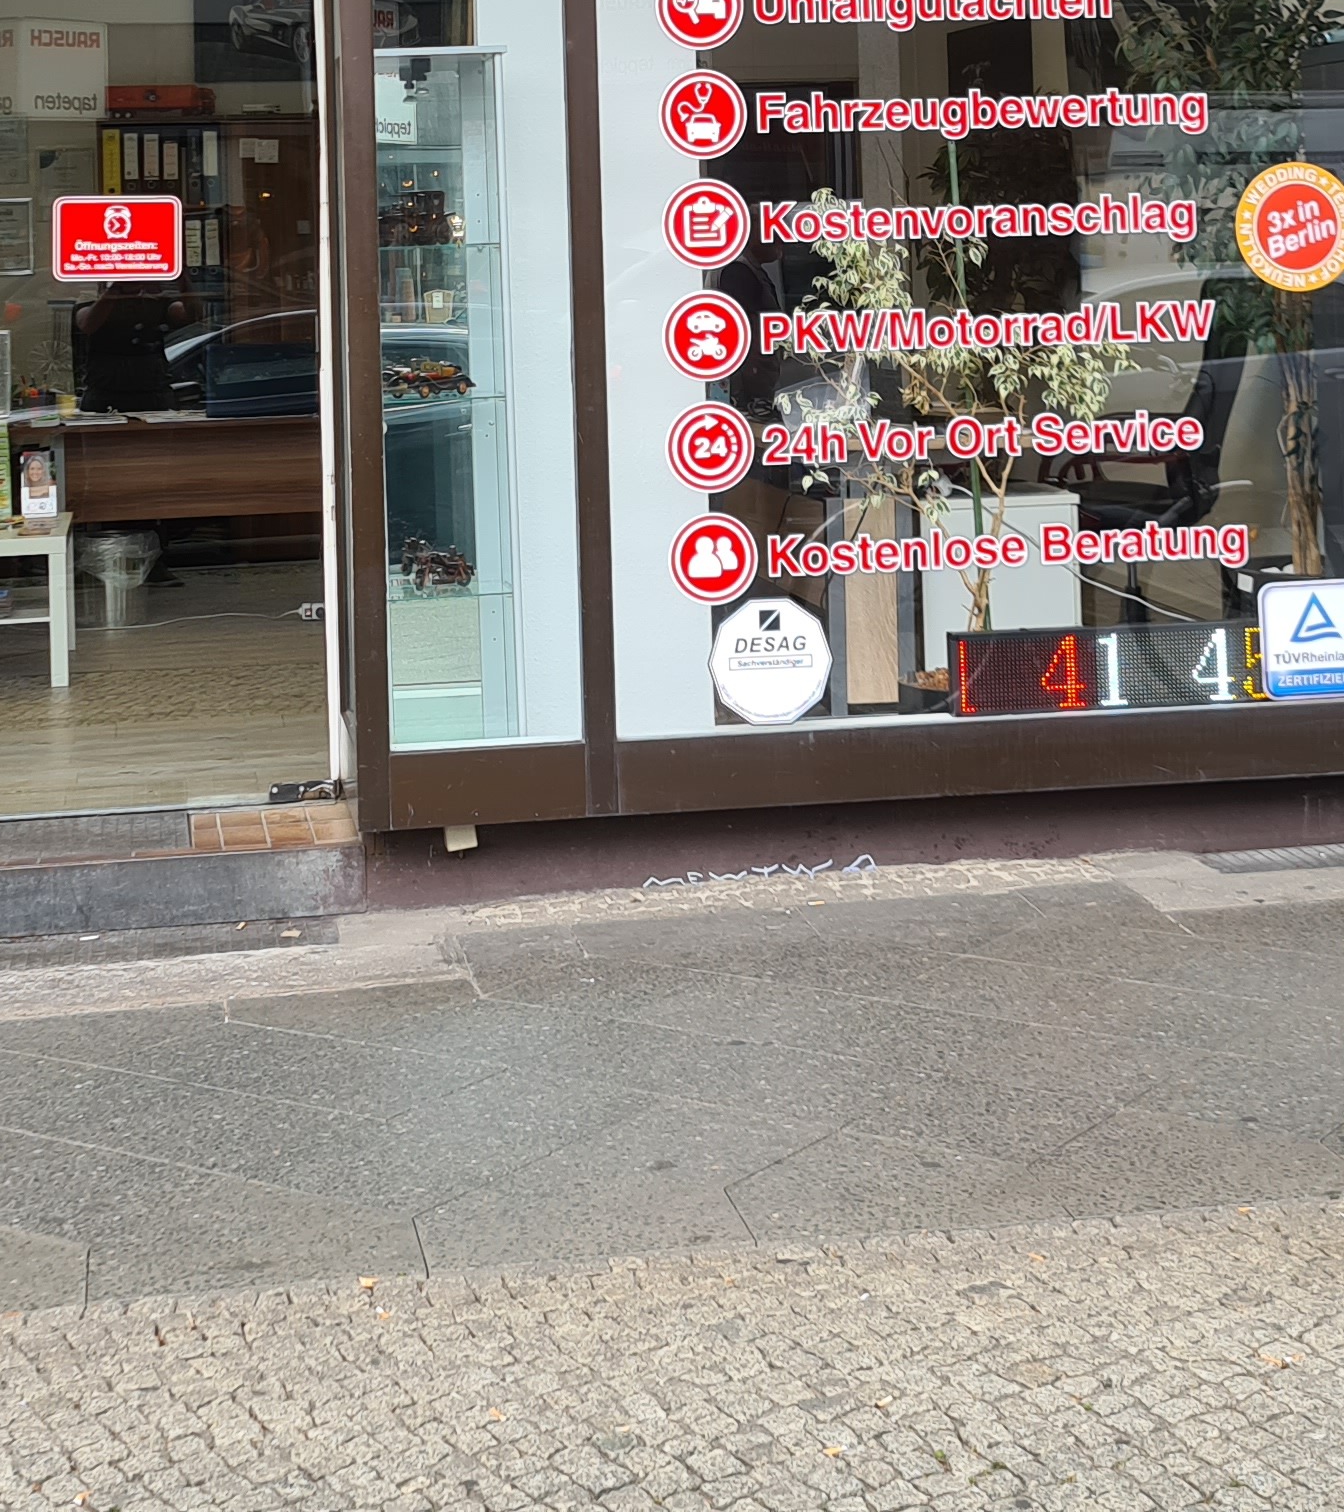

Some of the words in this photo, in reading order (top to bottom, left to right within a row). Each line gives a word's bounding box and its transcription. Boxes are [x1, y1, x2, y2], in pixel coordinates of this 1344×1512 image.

[757, 88, 1209, 139] Fahrzeugbewertung
[1244, 165, 1318, 206] WEDDING
[760, 193, 1197, 244] Kostenvoranschlag
[1266, 210, 1297, 234] 3x
[1297, 199, 1321, 224] in
[1266, 218, 1338, 260] Berlin
[760, 299, 1215, 355] PKW/Motorrad/LKW
[693, 435, 729, 460] 24
[763, 424, 846, 466] 24h
[857, 421, 934, 461] Vor
[946, 416, 1021, 458] Ort
[1034, 411, 1203, 454] Service
[768, 529, 1027, 577] Kostenlose
[1040, 522, 1249, 569] Beratung
[734, 635, 808, 655] DESAG
[737, 657, 805, 669] Sachverständiger
